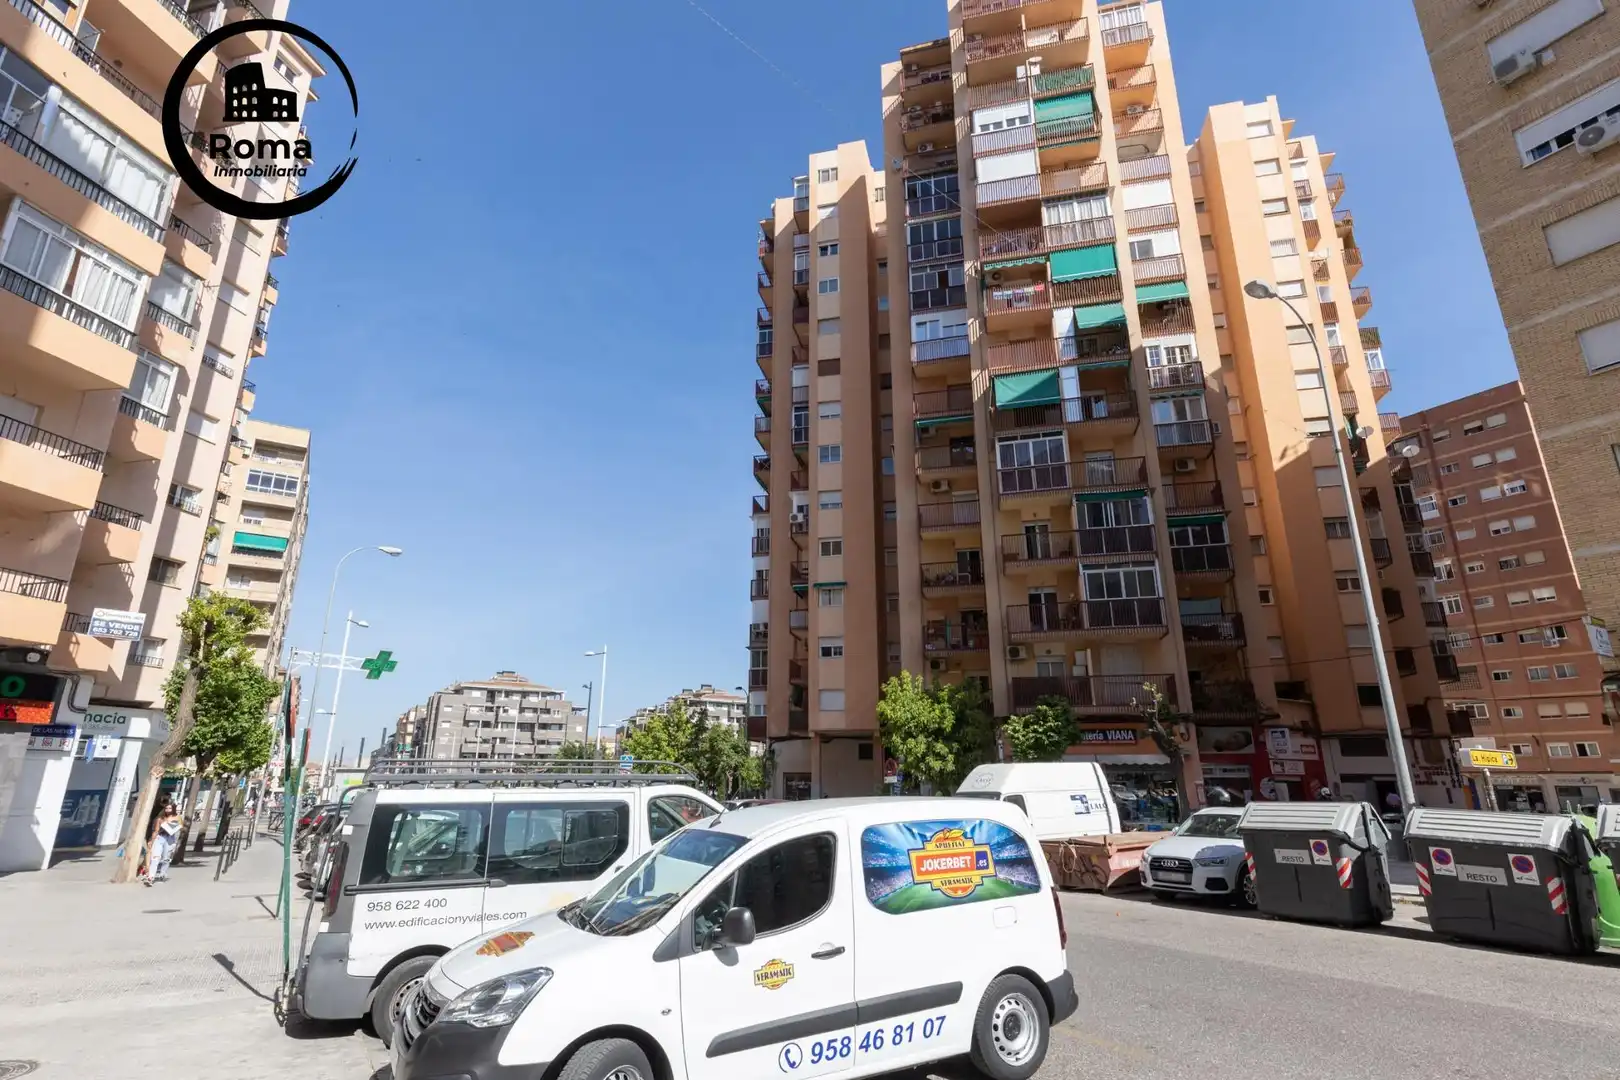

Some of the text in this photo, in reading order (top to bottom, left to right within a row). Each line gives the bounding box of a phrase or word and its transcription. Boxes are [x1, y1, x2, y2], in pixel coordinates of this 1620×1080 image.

[108, 621, 140, 631] VENDE
[1106, 729, 1134, 740] VIANA
[920, 855, 987, 872] JOKERBET .es
[1281, 855, 1305, 863] RESTO
[1466, 872, 1498, 883] RESTO
[367, 898, 448, 912] 958 622 400
[364, 910, 528, 930] www.edificacionyviales.com
[810, 1015, 947, 1064] 958 46 81 07
